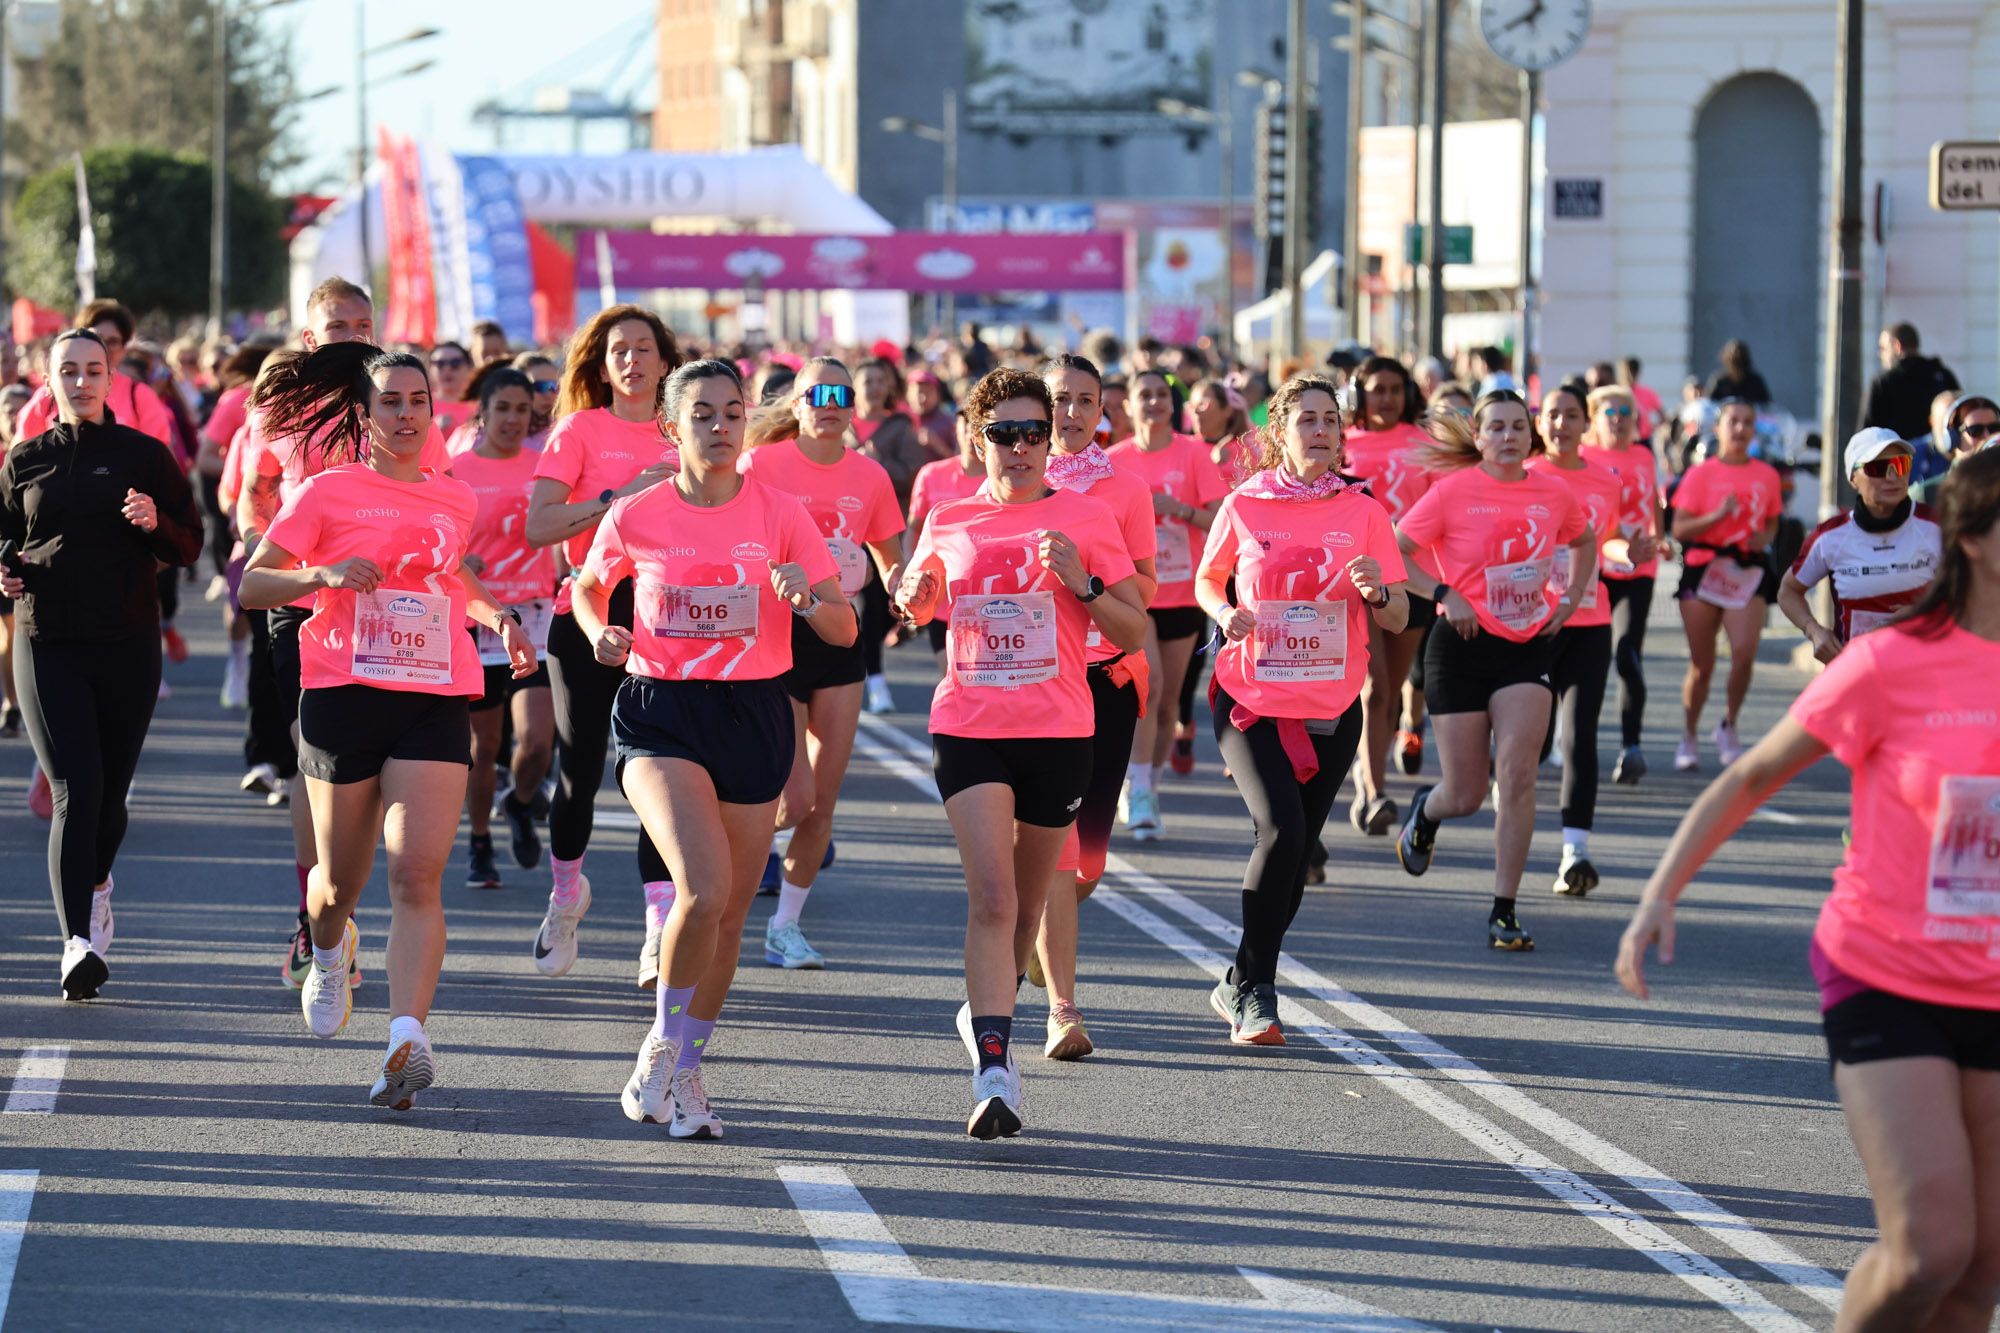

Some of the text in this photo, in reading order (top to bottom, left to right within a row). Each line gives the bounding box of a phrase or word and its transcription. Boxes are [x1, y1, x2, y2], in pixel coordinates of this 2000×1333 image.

[1947, 156, 2000, 172] cem
[511, 163, 705, 207] OYSHO
[1947, 180, 1983, 200] del
[600, 451, 634, 460] OYSHO
[356, 508, 400, 519] OYSHO
[1252, 530, 1291, 540] OYSHO
[1514, 590, 1538, 605] 016
[391, 603, 424, 614] ASTURIANA
[689, 604, 728, 619] 016
[983, 607, 1021, 615] ASTURIANA
[1285, 611, 1317, 620] ASTURIANA
[697, 623, 716, 631] 5668
[665, 630, 688, 638] CARRERA
[723, 630, 746, 638] VALENCIA
[390, 631, 425, 648] 016
[987, 634, 1025, 650] 016
[1286, 636, 1320, 650] 016
[396, 650, 414, 658] 6789
[995, 653, 1013, 661] 2089
[366, 656, 388, 664] CARRERA
[363, 666, 396, 676] OYSHO
[414, 671, 440, 680] Santander
[1016, 671, 1047, 680] Santander
[1265, 669, 1294, 678] OYSHO
[966, 673, 997, 681] OYSHO
